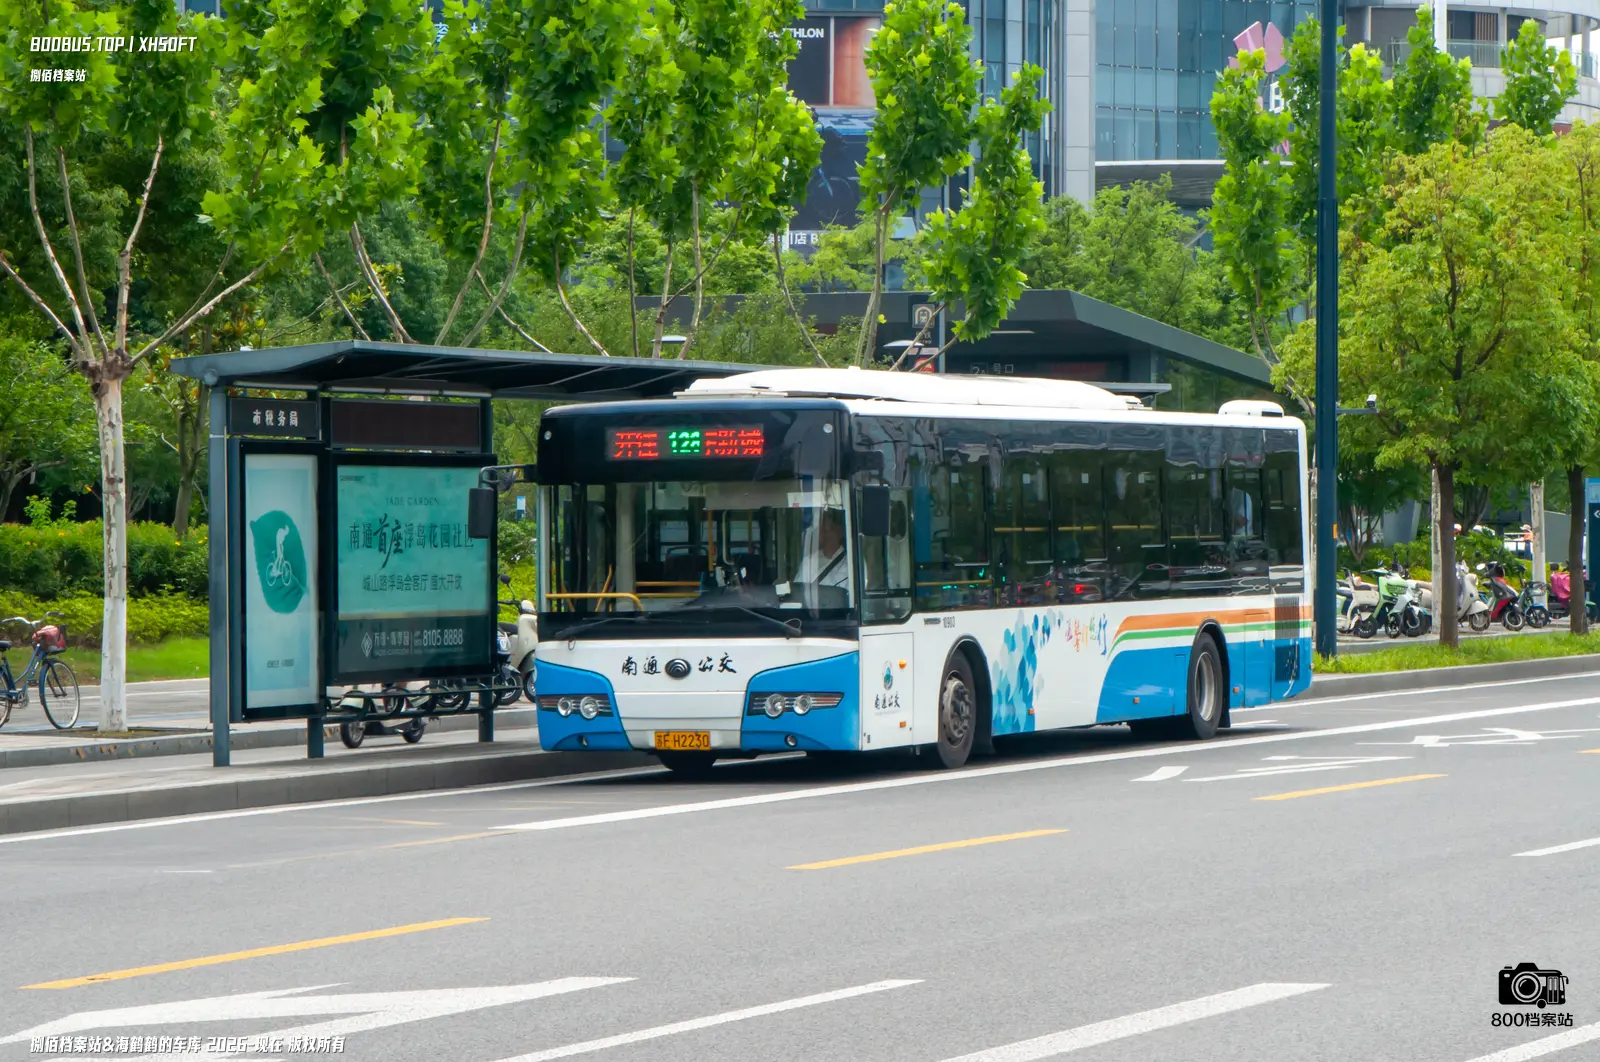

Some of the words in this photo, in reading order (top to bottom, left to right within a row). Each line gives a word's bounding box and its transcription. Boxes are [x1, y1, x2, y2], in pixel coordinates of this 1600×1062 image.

[252, 409, 298, 427] 市税务局
[423, 630, 442, 647] 8105
[443, 628, 463, 645] 8888
[621, 655, 662, 676] 南通
[698, 652, 737, 674] 公交
